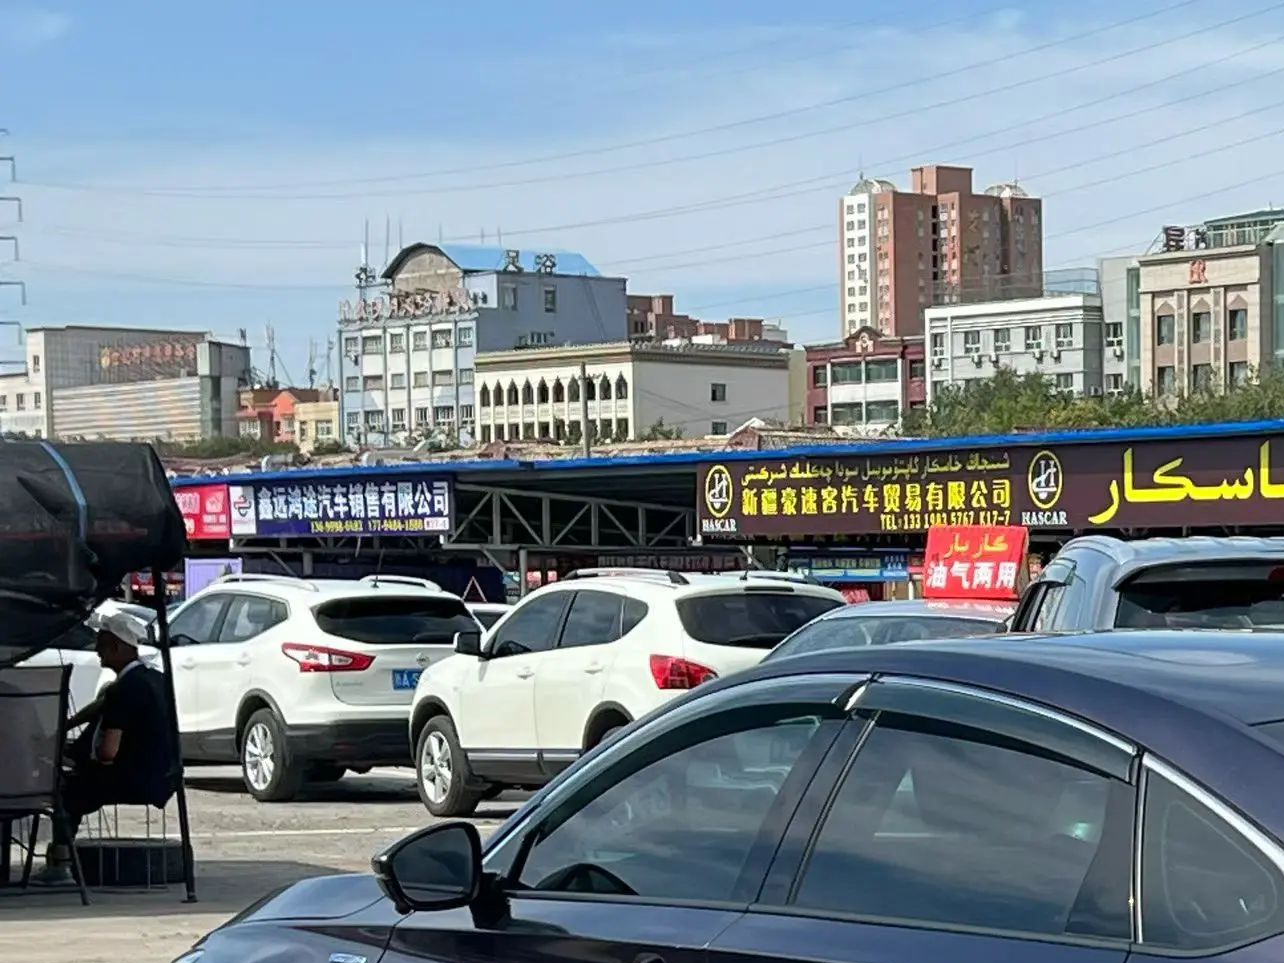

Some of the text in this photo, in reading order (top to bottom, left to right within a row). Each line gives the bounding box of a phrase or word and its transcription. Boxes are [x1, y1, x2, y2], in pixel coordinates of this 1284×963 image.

[741, 480, 1011, 516] 新疆豪速客汽车贸易有限公司
[702, 518, 737, 532] HASCAR
[1021, 511, 1068, 526] HASCAR
[926, 560, 1018, 590] 油气两用
